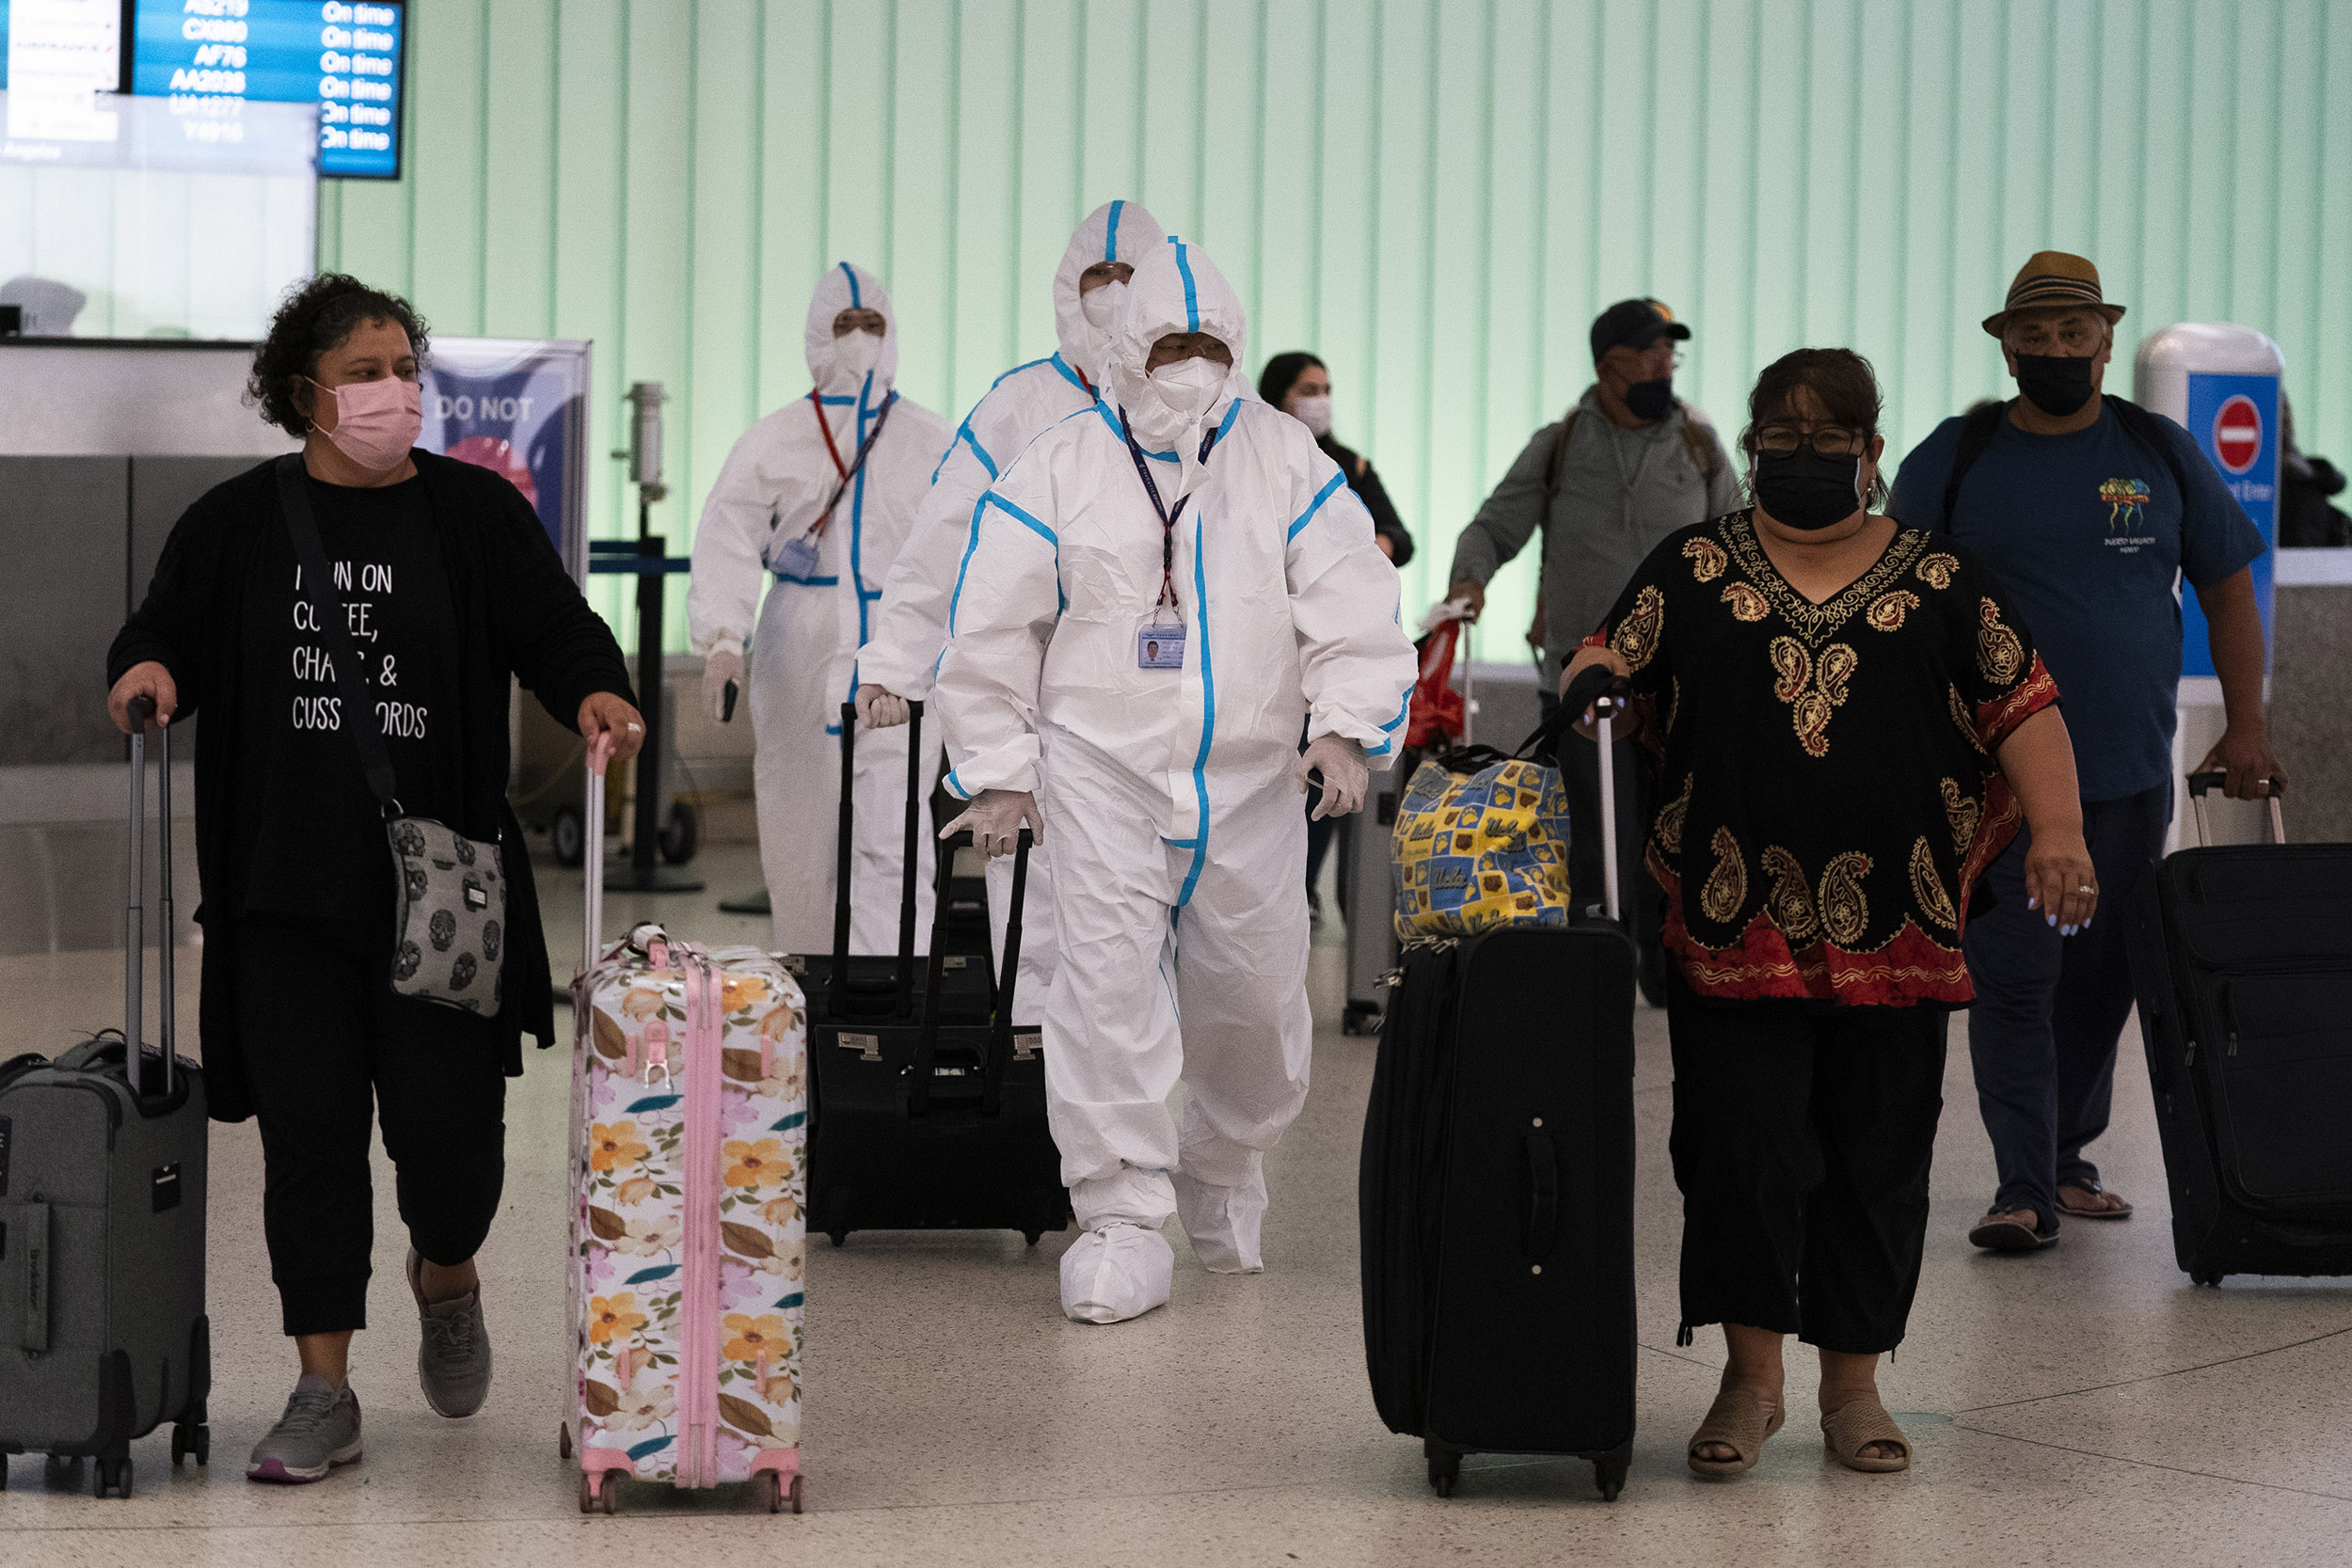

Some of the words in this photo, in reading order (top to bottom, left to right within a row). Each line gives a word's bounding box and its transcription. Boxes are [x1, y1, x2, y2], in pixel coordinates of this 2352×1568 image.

[322, 1, 353, 24] On
[354, 3, 395, 26] time
[321, 25, 352, 48] On
[353, 27, 394, 51] time
[320, 51, 351, 73] On
[352, 53, 393, 76] time
[319, 75, 350, 99] On
[351, 77, 392, 101] time
[350, 103, 391, 126] time
[349, 127, 390, 150] time
[435, 394, 474, 421] DO
[480, 396, 535, 422] NOT
[361, 563, 392, 594] ON
[293, 600, 378, 643] COEE,
[292, 645, 370, 686] CHA
[379, 654, 398, 687] &
[292, 695, 342, 731] CUSS
[374, 701, 428, 739] ORDS
